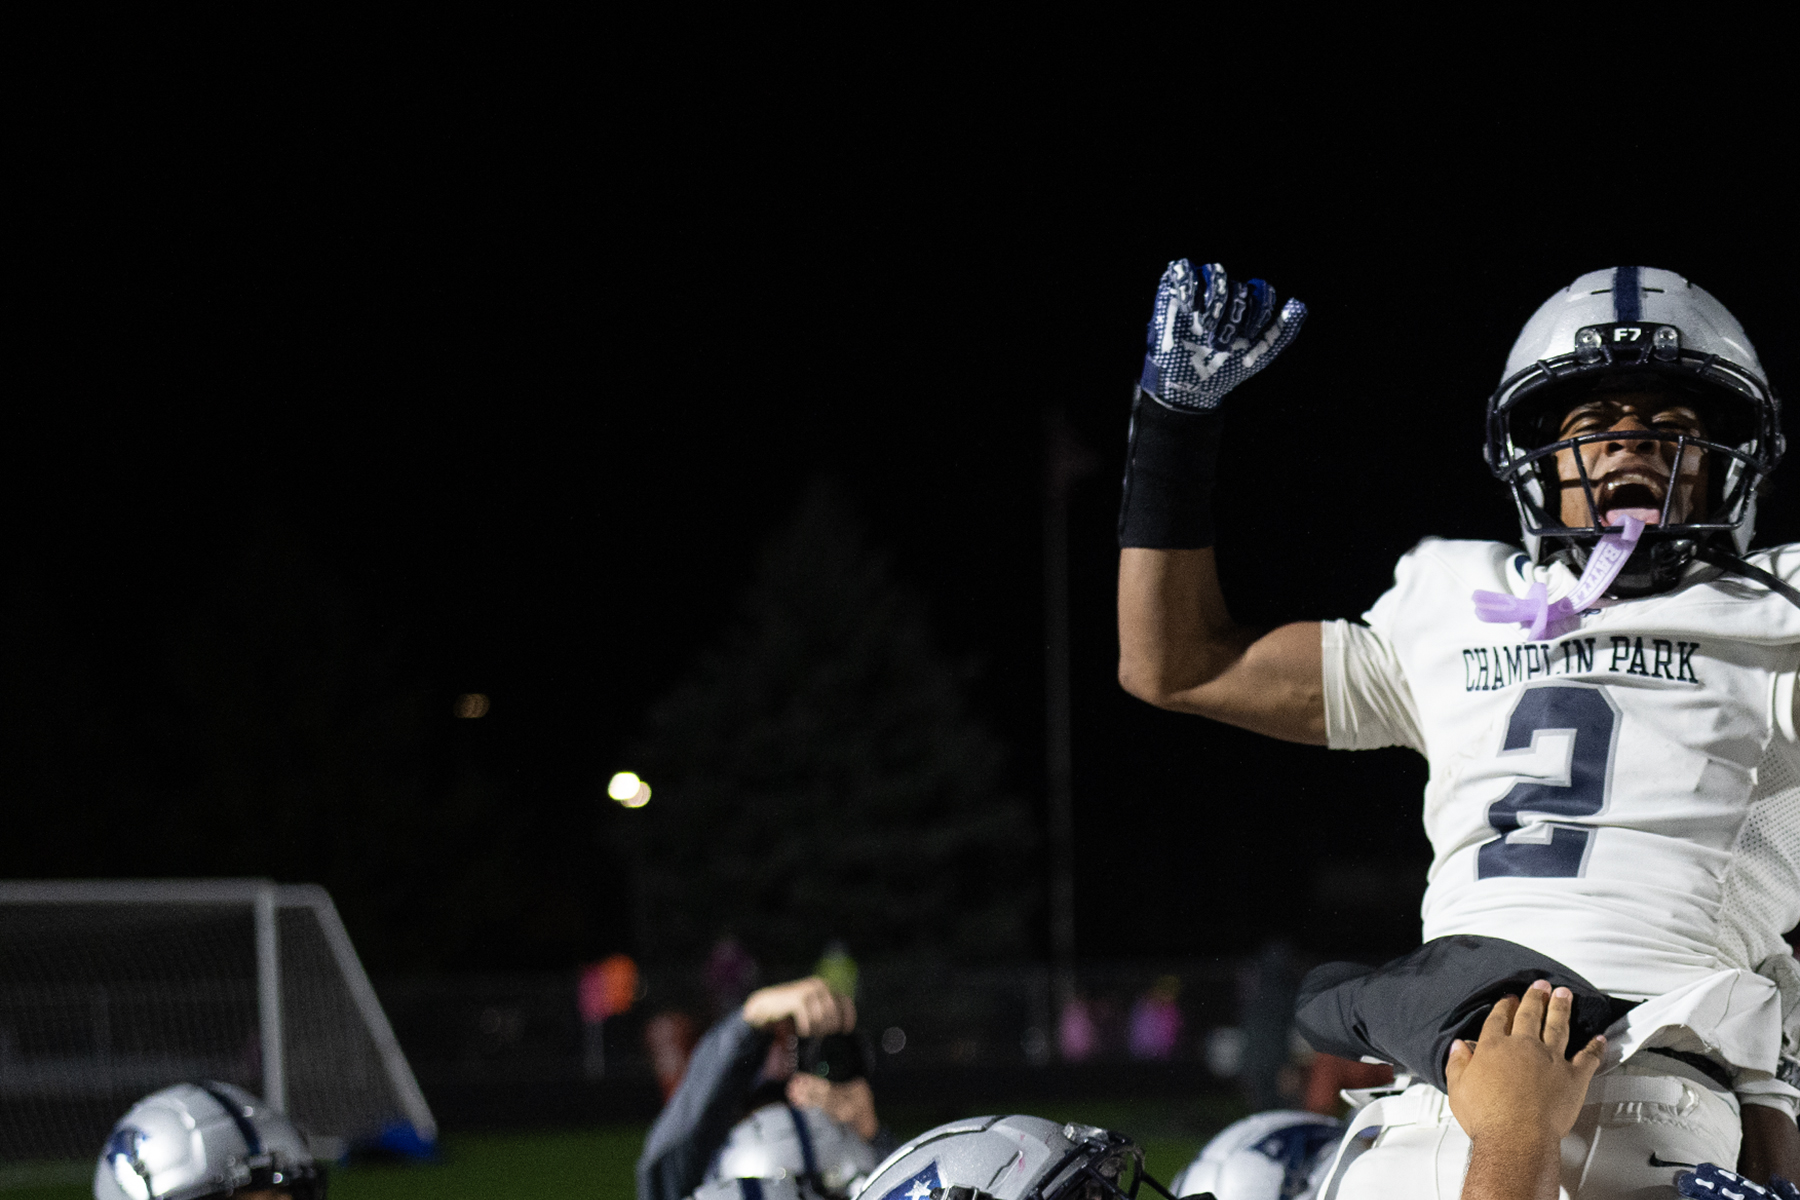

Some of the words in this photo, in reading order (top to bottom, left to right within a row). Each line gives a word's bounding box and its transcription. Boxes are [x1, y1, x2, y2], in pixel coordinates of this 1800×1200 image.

[1613, 328, 1642, 342] F7
[1463, 638, 1596, 692] CHAMPLIN
[1609, 634, 1702, 684] PARK
[1472, 680, 1622, 880] 2
